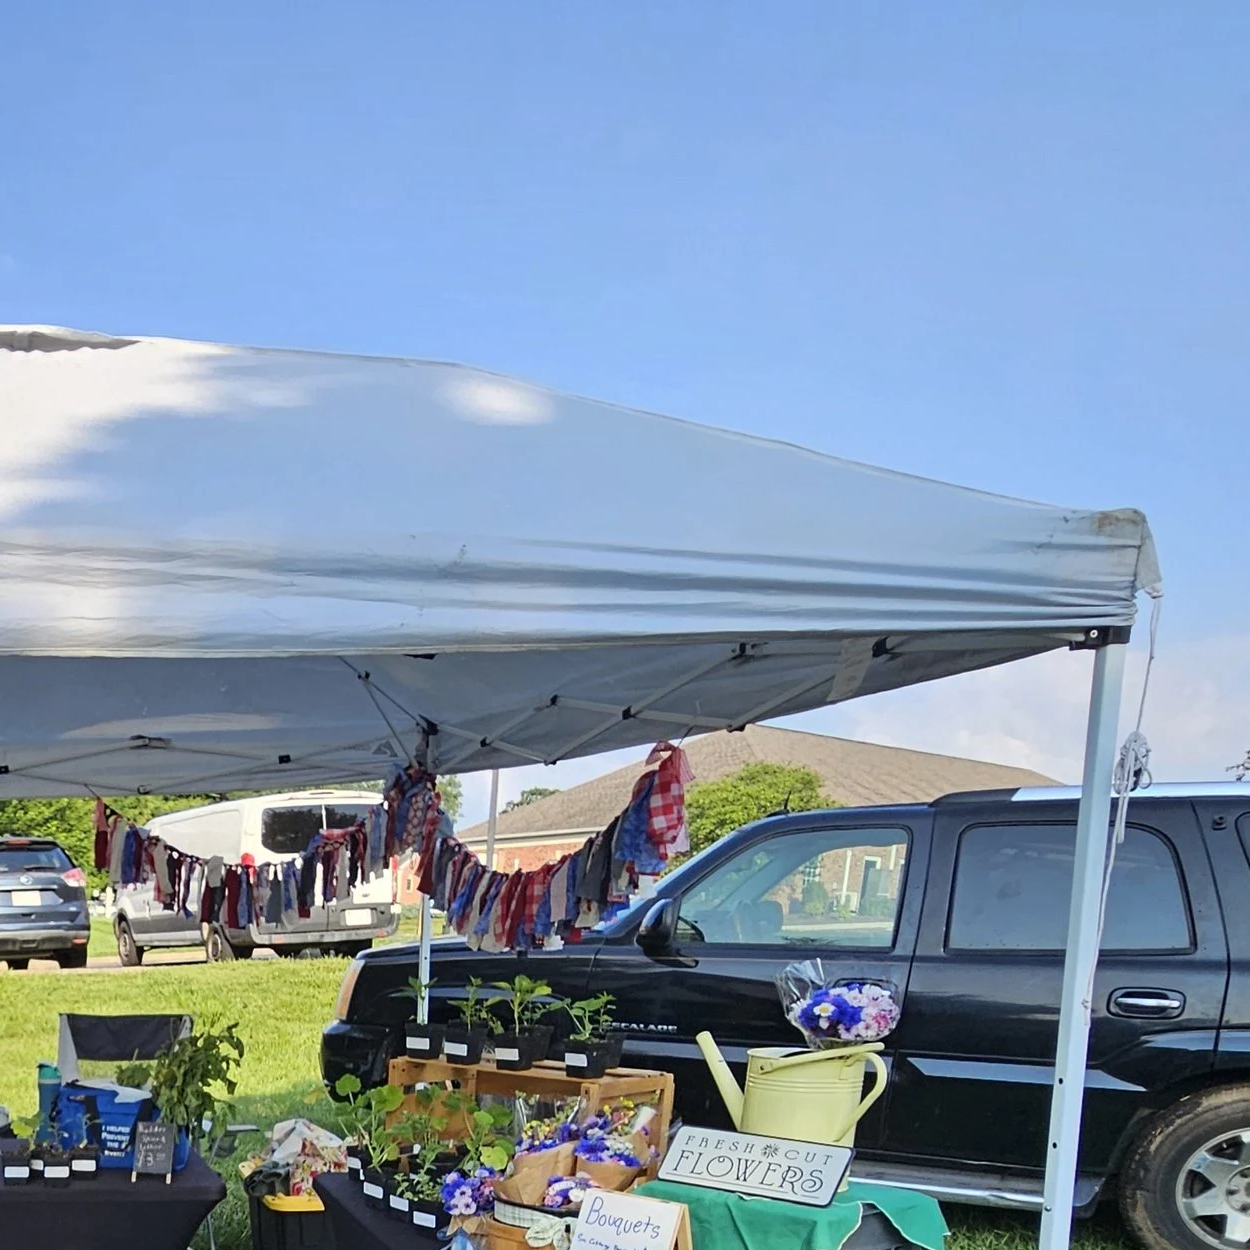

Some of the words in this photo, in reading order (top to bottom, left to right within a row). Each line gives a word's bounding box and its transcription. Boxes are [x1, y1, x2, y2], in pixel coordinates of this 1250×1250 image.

[685, 1135, 755, 1154] FRESH
[784, 1149, 833, 1166] CUT
[672, 1150, 824, 1196] FLOWERS
[585, 1196, 661, 1239] Bouquets
